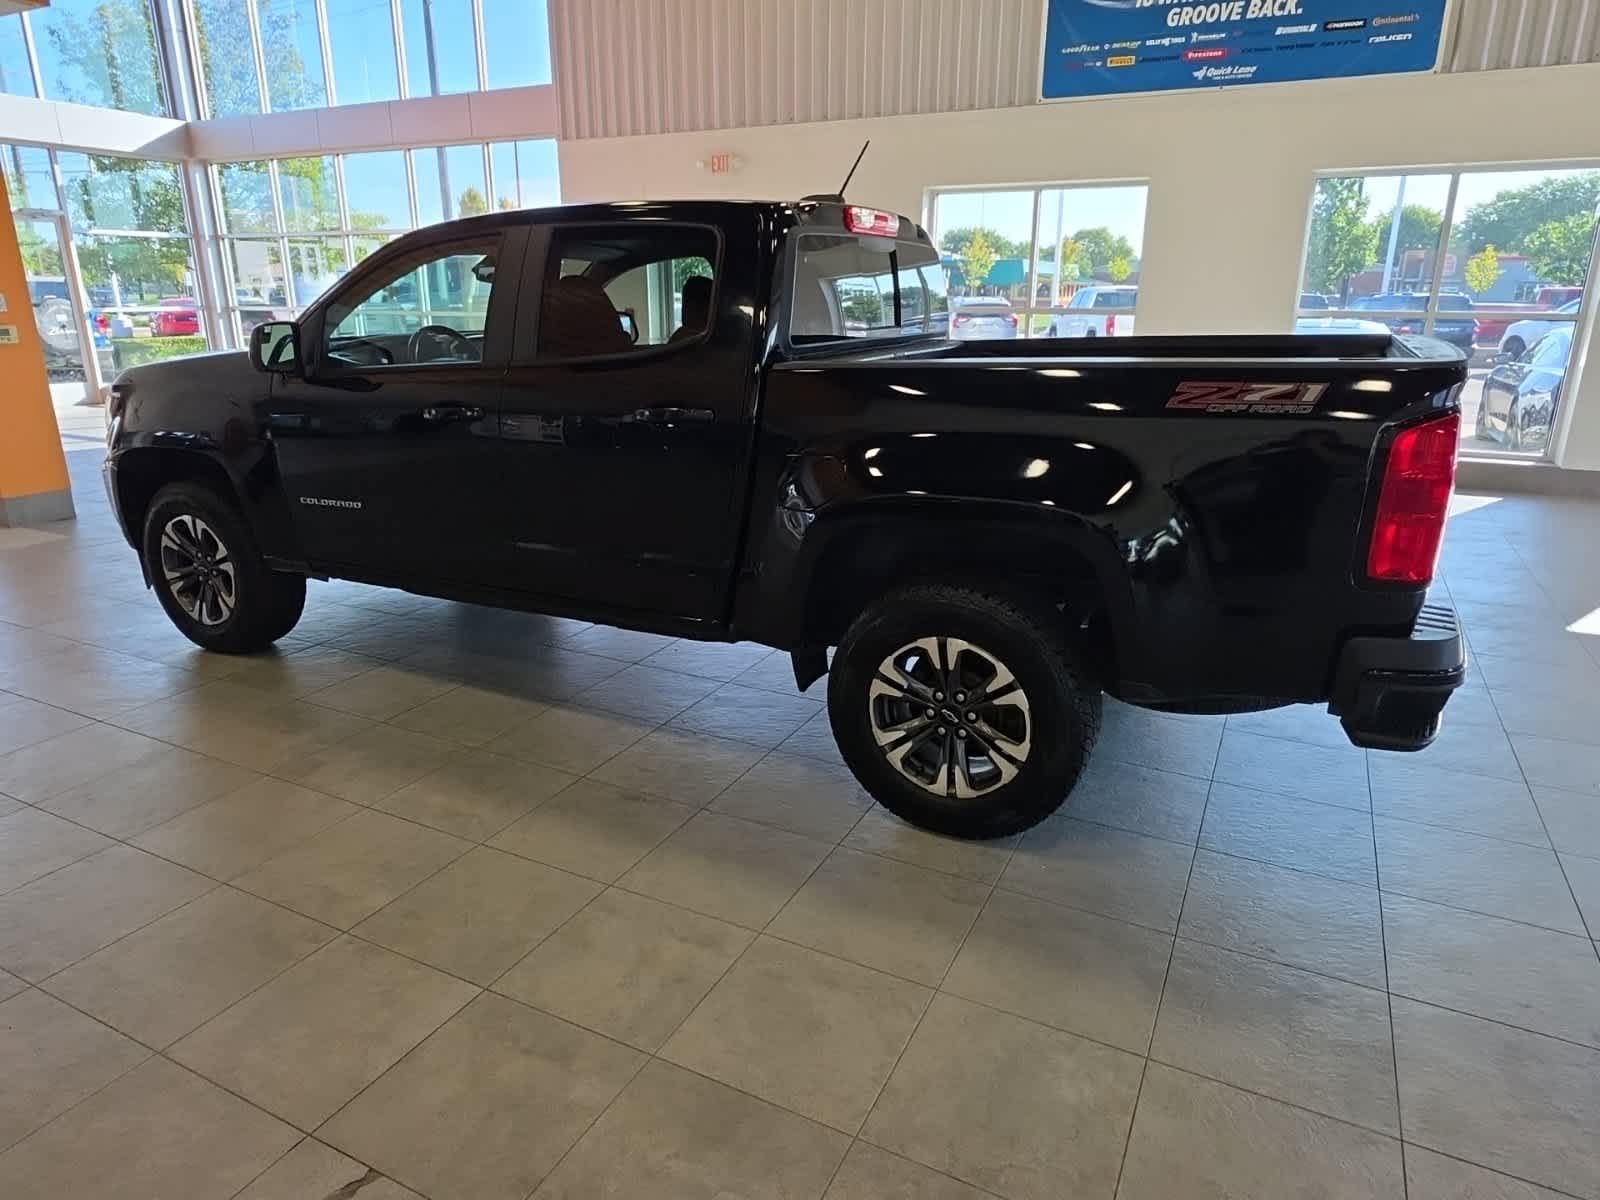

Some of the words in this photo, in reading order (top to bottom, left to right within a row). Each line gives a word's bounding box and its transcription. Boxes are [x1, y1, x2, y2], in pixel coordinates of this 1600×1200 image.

[1166, 1, 1245, 27] GROOVE
[1246, 0, 1303, 20] BACK.
[1372, 13, 1414, 26] Continental
[1369, 33, 1412, 43] FALKEN
[1188, 51, 1223, 59] Firestone
[1207, 66, 1233, 77] Quick
[1232, 65, 1257, 74] Lane
[1165, 382, 1330, 408] Z71
[1206, 404, 1249, 413] OFF
[1249, 404, 1313, 414] ROAD
[300, 496, 362, 509] COLORADO
